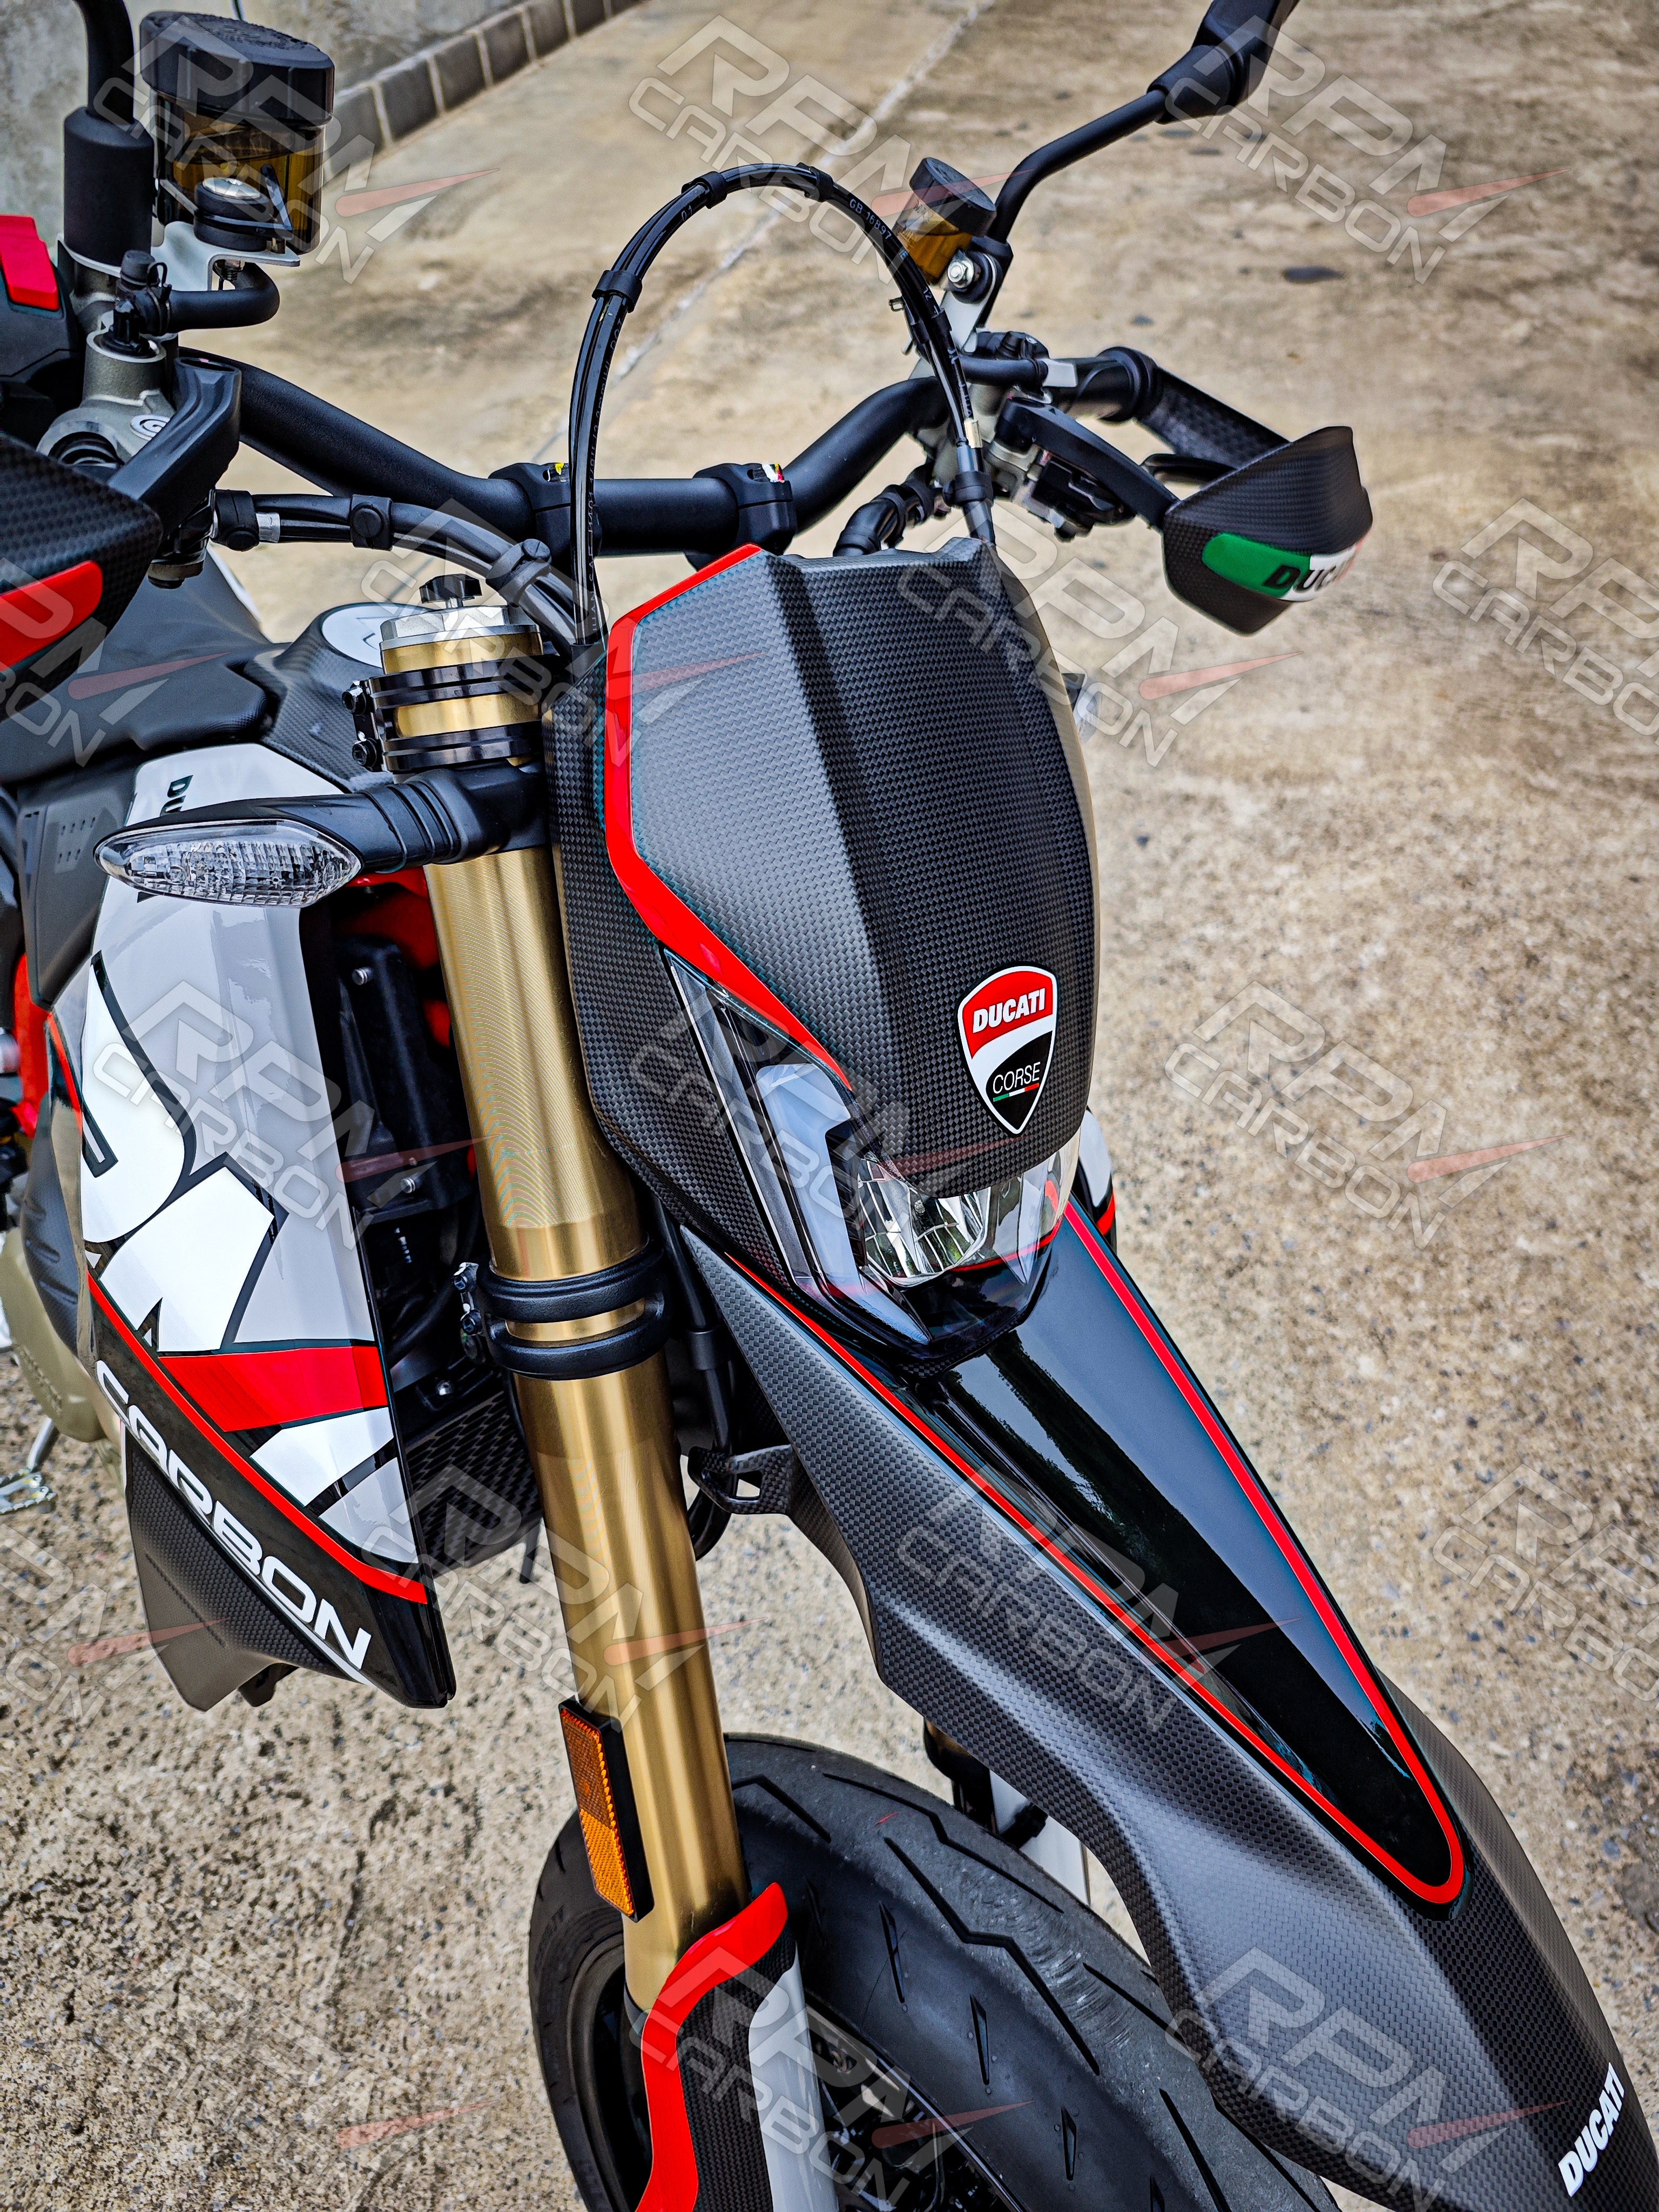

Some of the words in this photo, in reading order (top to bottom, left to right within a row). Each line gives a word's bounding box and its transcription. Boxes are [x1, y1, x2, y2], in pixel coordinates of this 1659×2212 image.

[973, 988, 1046, 1034] DUCATI
[993, 1061, 1041, 1094] CORSE
[96, 1360, 372, 1670] CARBON
[1558, 2061, 1624, 2198] DUCATI
